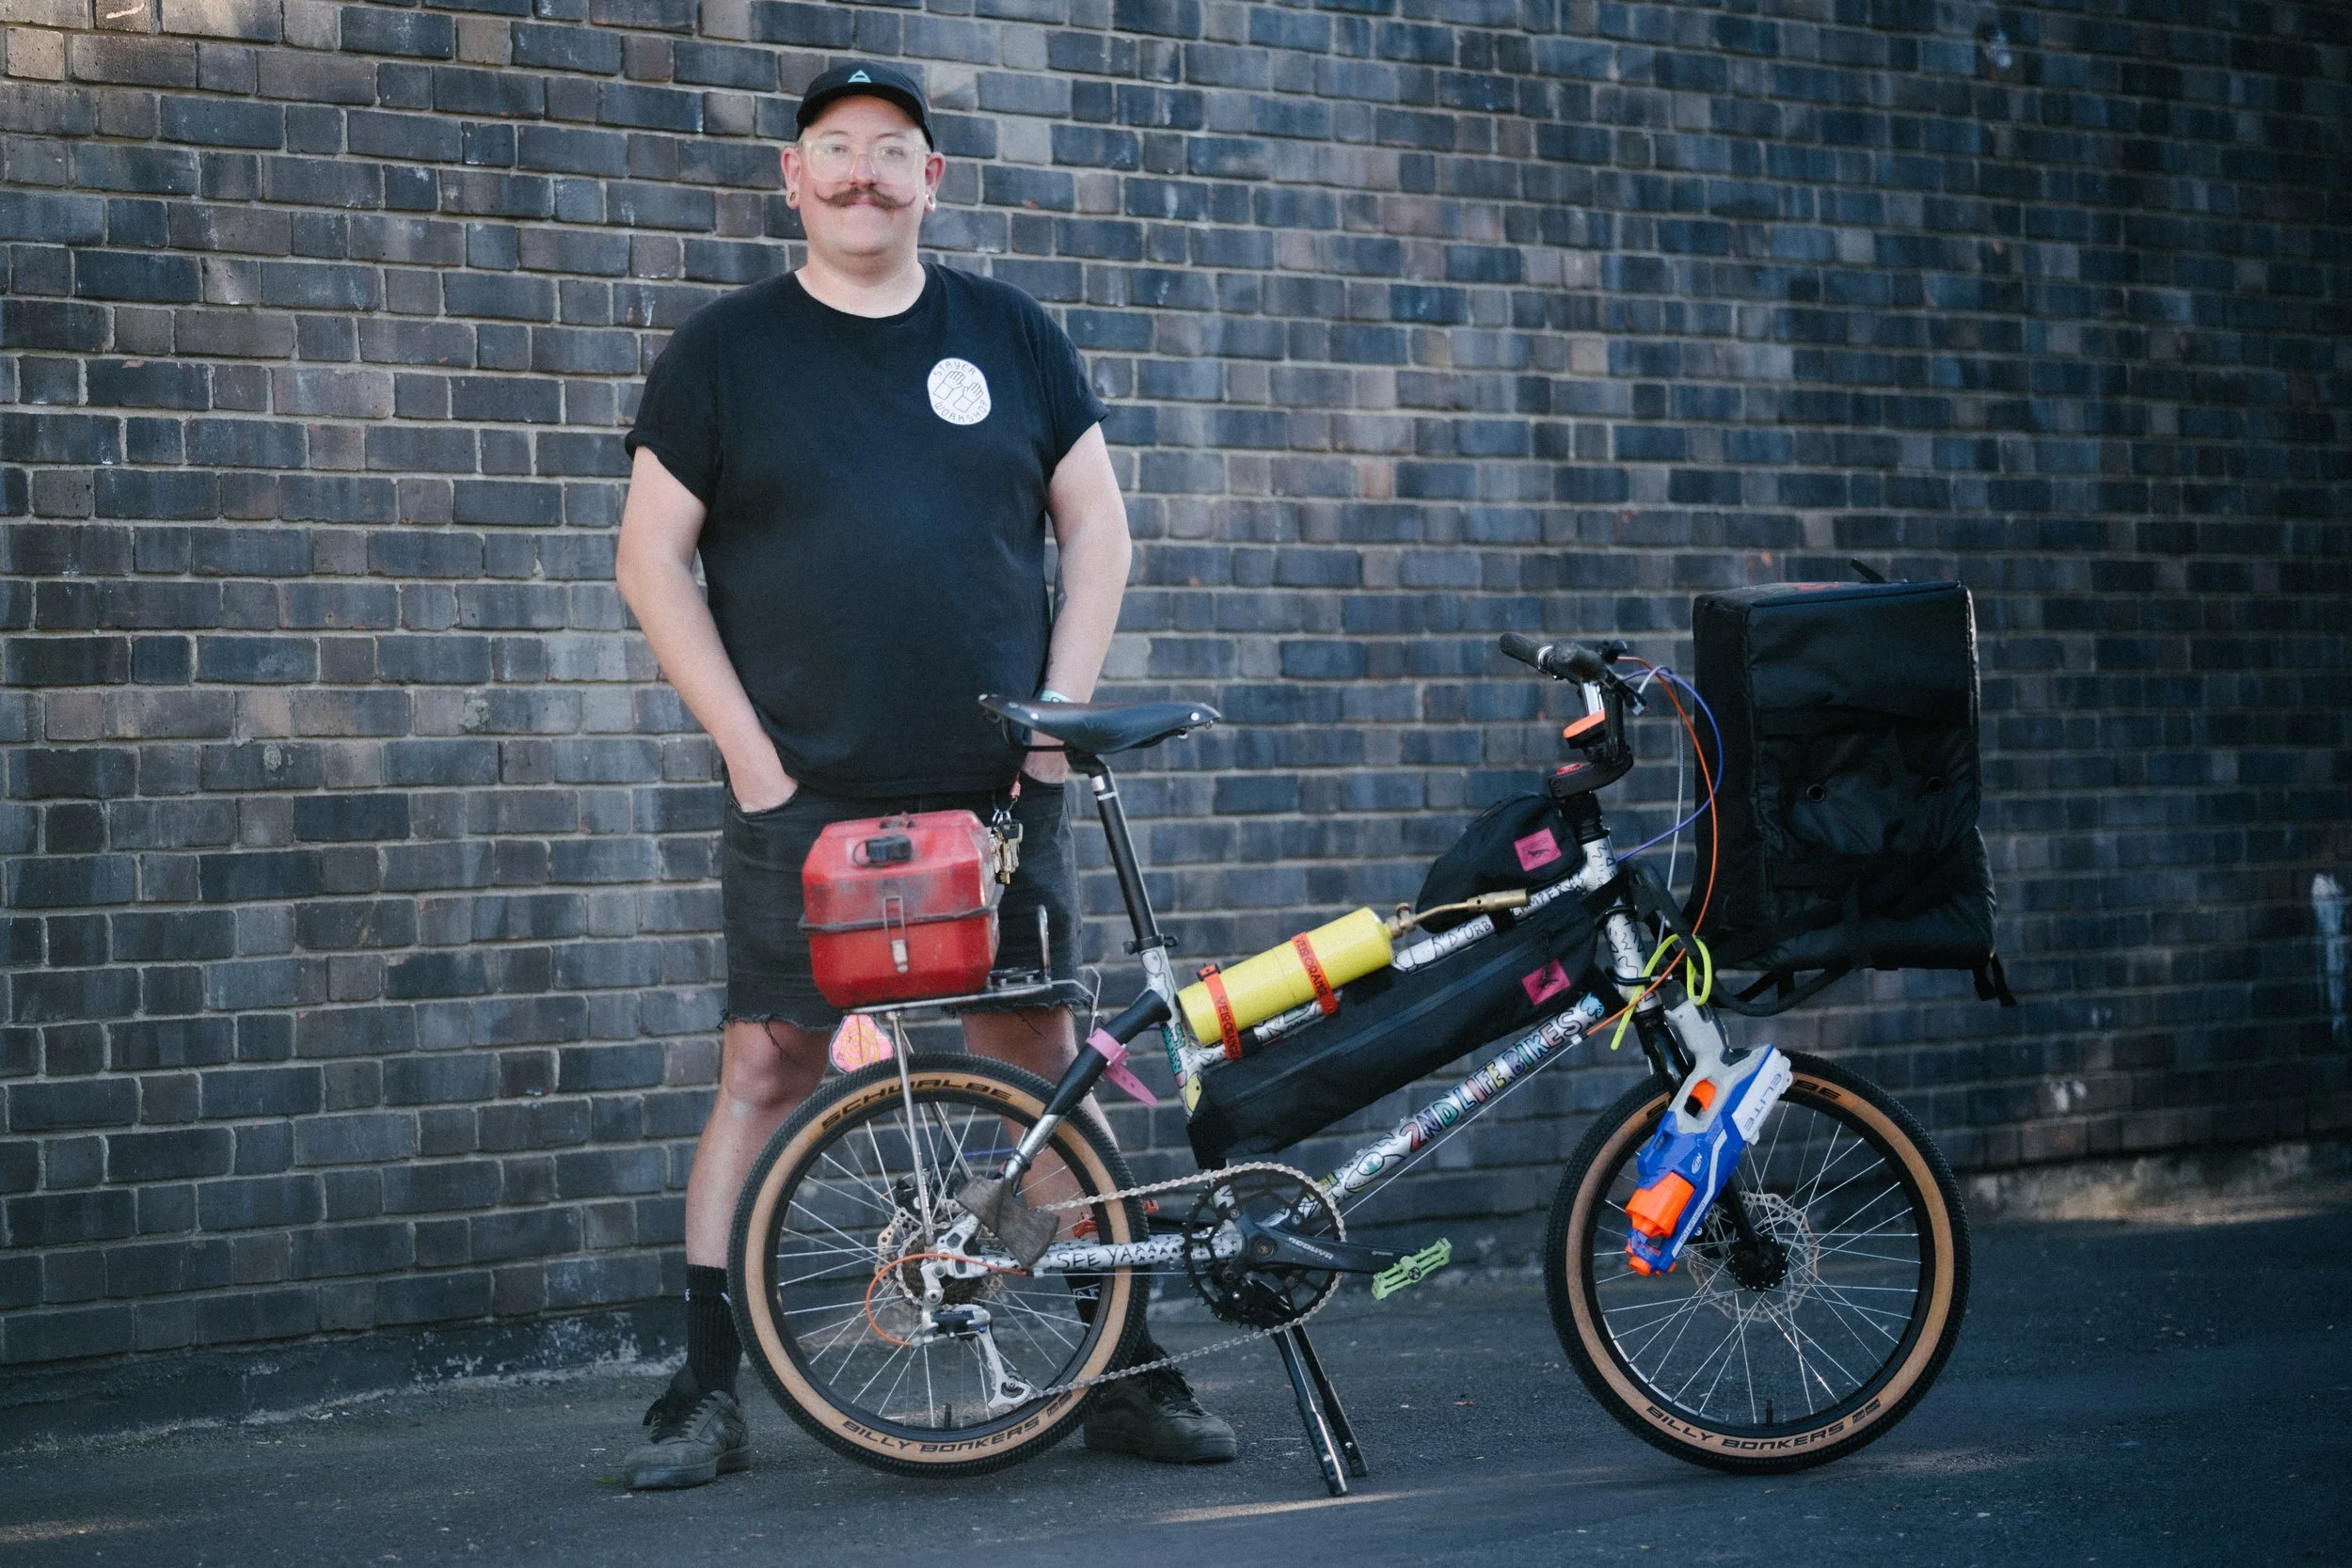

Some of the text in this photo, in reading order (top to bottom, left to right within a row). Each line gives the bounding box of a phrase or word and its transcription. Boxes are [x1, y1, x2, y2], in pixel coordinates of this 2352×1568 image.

[933, 360, 976, 376] STAYER
[934, 400, 988, 422] WORKSHOP
[1399, 1009, 1584, 1153] 2ND LIFE BIKES
[821, 1079, 1012, 1129] SCHWALBE
[1743, 1072, 1783, 1131] ELITE
[1057, 1252, 1102, 1269] SEE
[842, 1418, 1041, 1453] BILLY BONKERS
[1646, 1405, 1845, 1450] BILLY BONKERS
